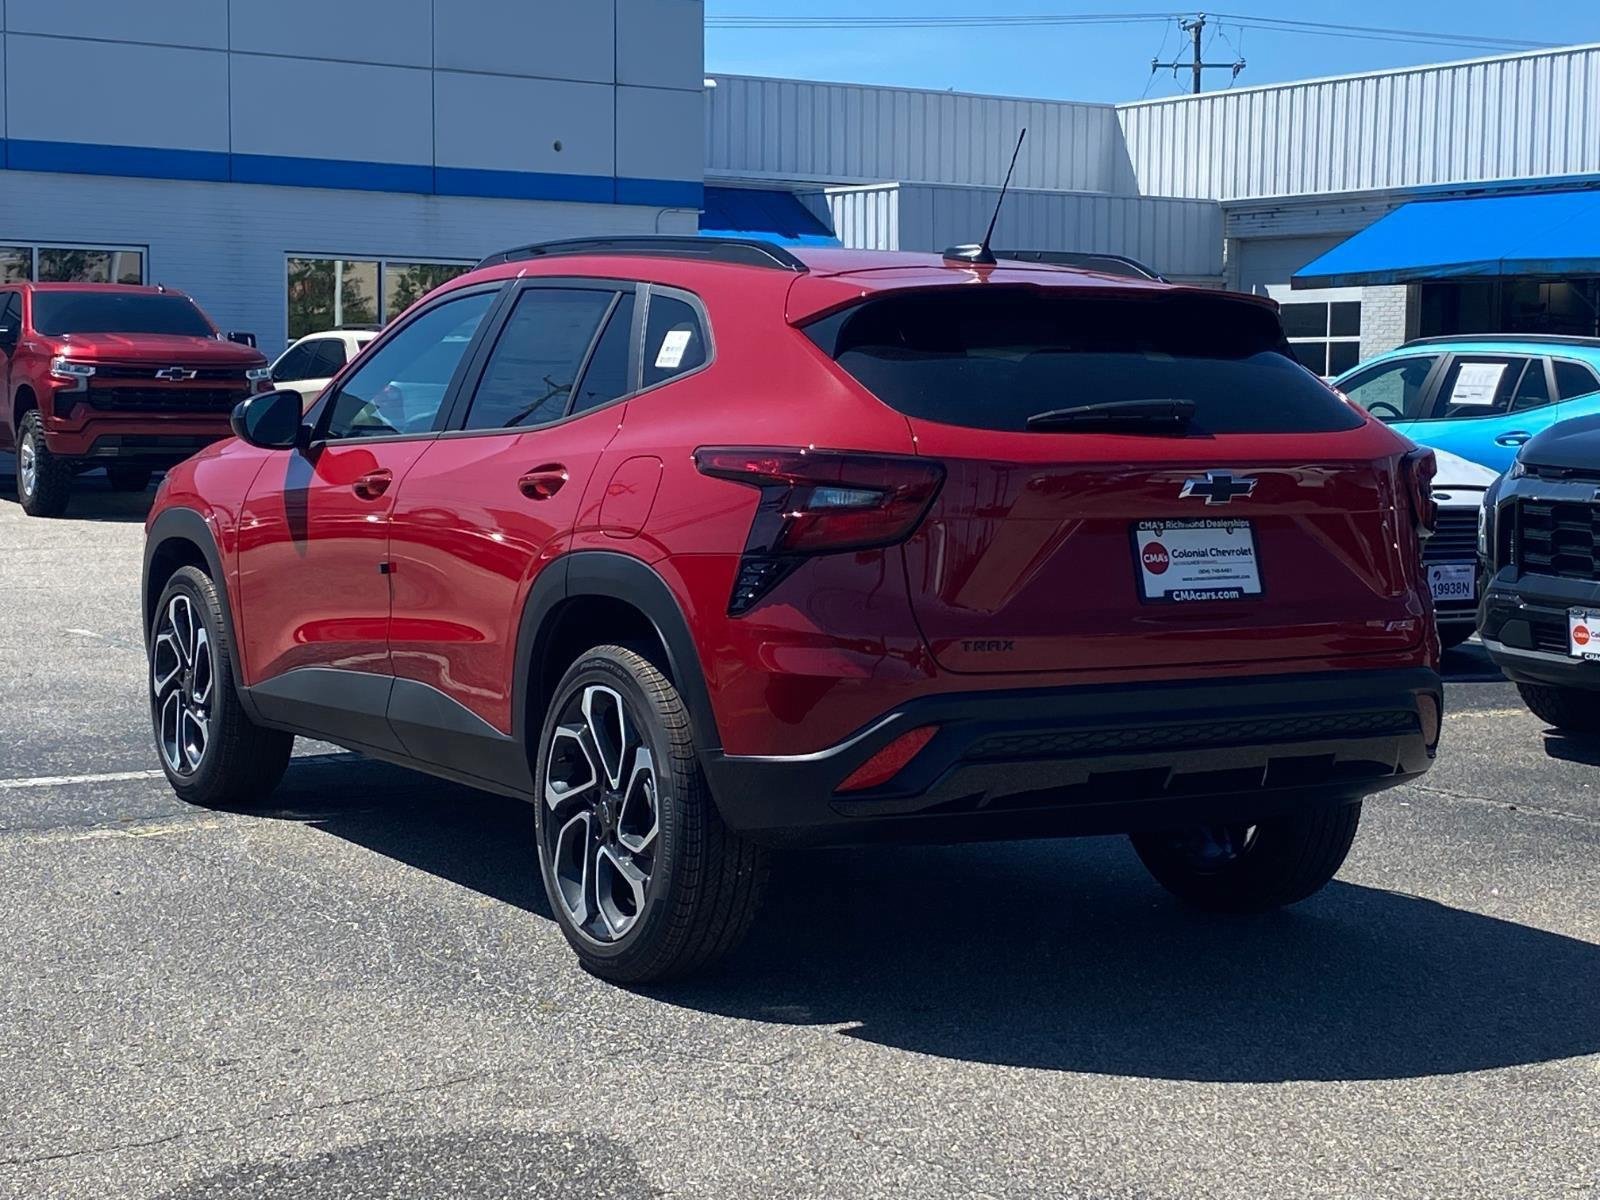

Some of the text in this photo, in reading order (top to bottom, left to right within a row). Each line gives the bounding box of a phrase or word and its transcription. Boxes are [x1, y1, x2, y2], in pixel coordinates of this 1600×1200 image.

[1139, 518, 1249, 530] CMA's Richmond Dealerships
[1171, 547, 1252, 558] Colonial Chevrolet
[1432, 581, 1470, 596] 19938N
[1172, 591, 1239, 601] CMAcars.com
[961, 640, 1015, 651] TRAX
